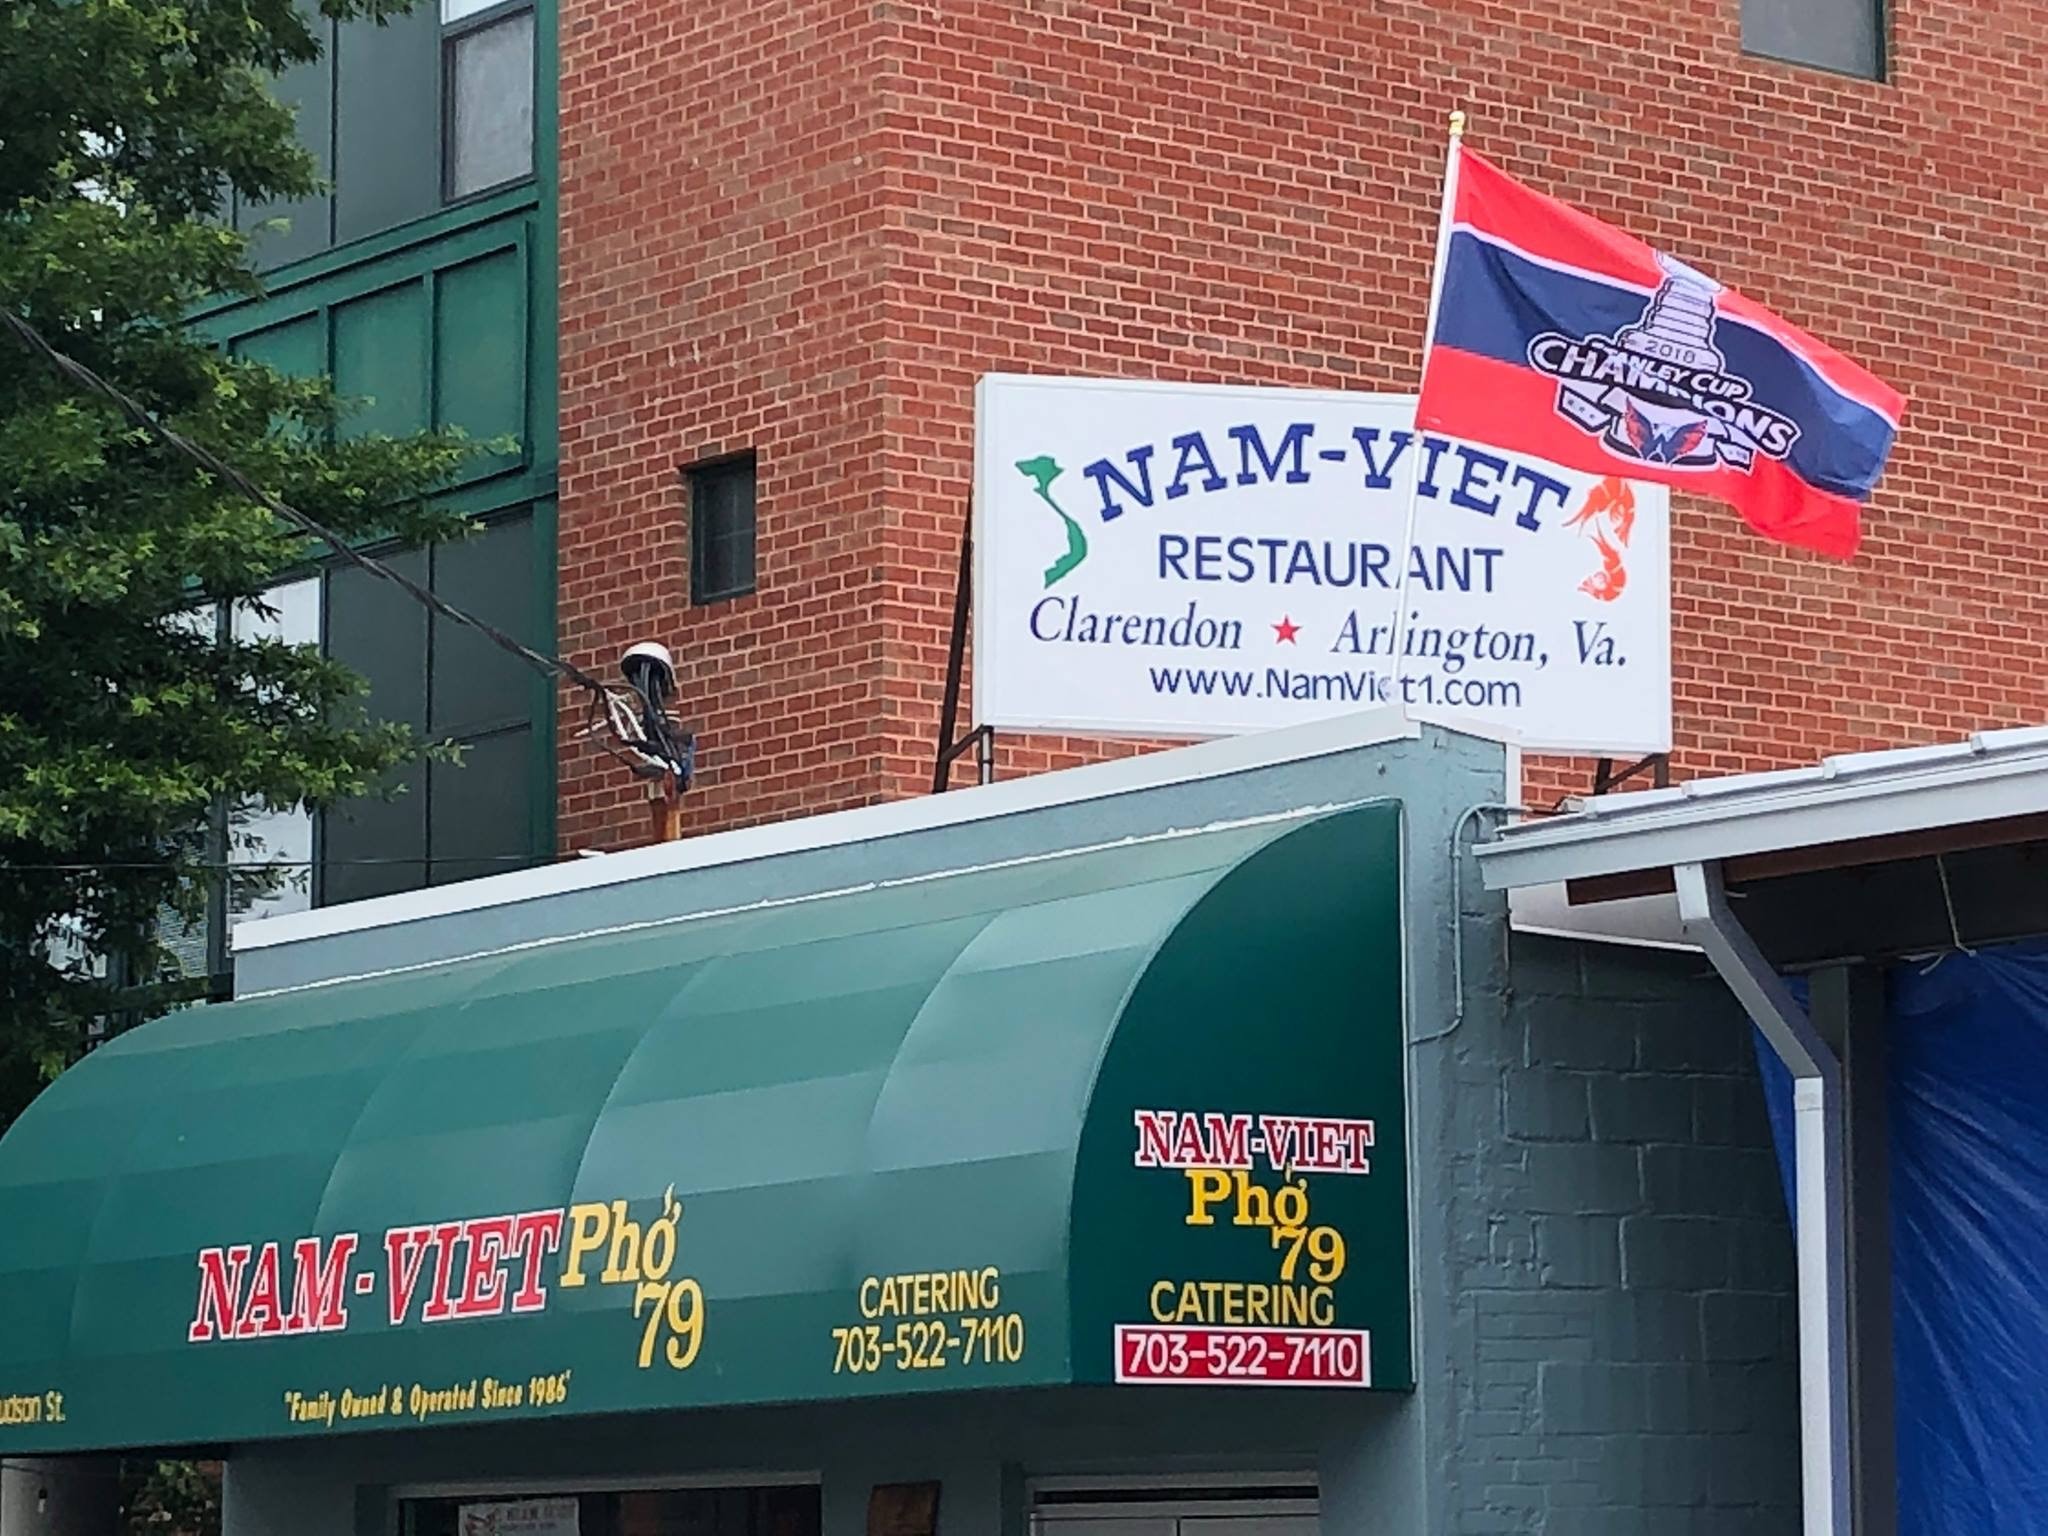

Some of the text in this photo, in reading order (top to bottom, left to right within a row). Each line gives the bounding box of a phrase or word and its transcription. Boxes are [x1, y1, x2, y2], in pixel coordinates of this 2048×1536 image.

[1644, 340, 1696, 364] 2018
[1690, 373, 1745, 398] CUP
[1083, 423, 1571, 533] NAM-VIET
[1158, 535, 1504, 593] RESTAURANT
[1029, 596, 1627, 674] Clarendon Arlington, Va.
[1134, 1109, 1375, 1175] NAM-VIET
[1271, 1225, 1347, 1284] 79
[860, 1266, 999, 1319] CATERING
[1150, 1280, 1335, 1327] CATERING
[633, 1278, 705, 1370] 79
[832, 1313, 1024, 1374] 703-522-7110
[1126, 1333, 1358, 1378] 703-522-7110
[340, 1387, 387, 1419] Owned
[390, 1384, 403, 1415] &
[409, 1383, 477, 1422] Operated
[481, 1377, 523, 1409] Since
